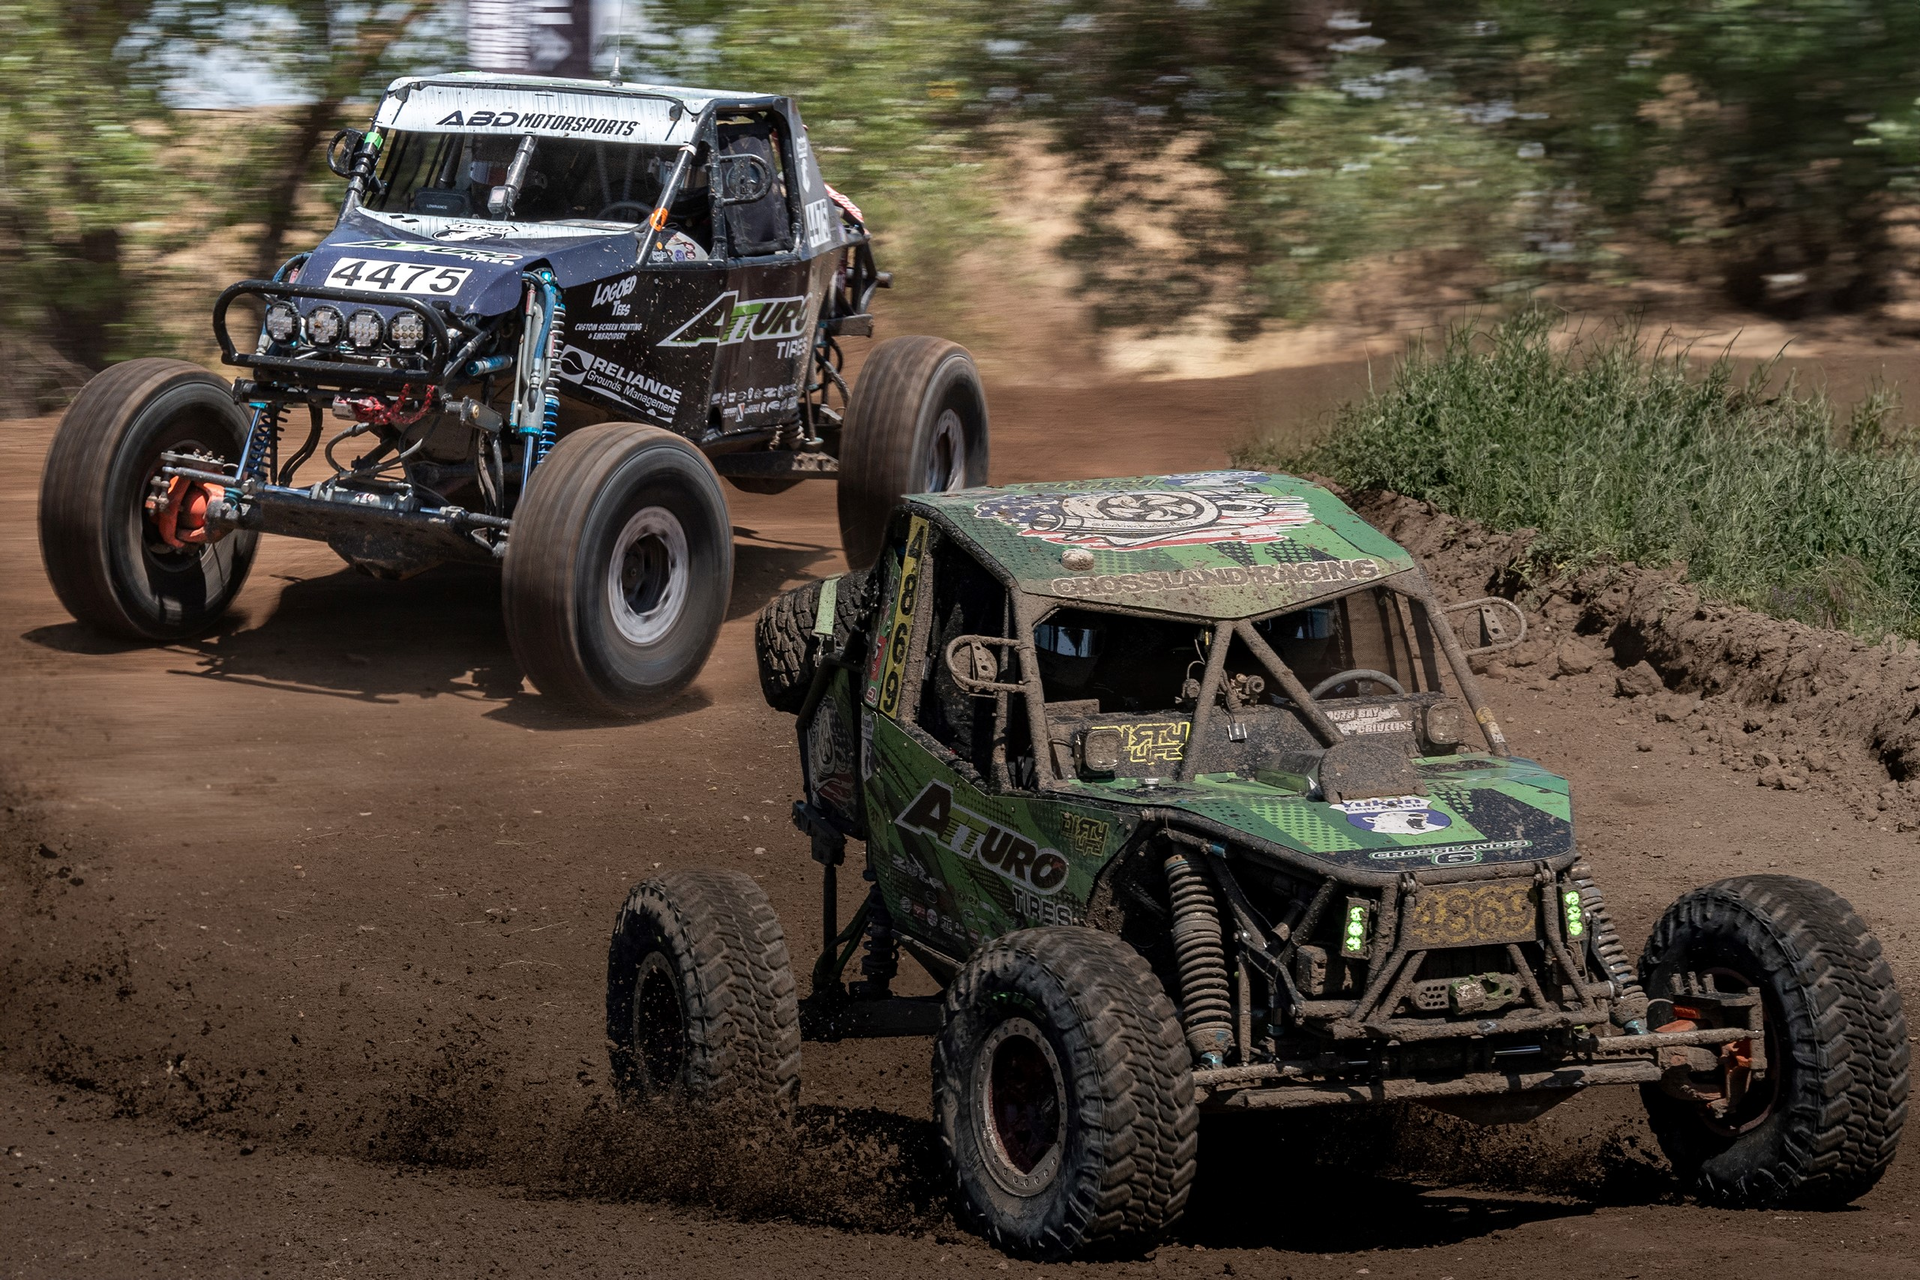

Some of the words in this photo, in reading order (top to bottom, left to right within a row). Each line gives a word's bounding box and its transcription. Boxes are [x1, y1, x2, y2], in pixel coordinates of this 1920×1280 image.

[436, 110, 519, 127] ABD
[517, 112, 640, 136] MOTORSPORTS
[331, 260, 467, 293] 4475
[460, 255, 515, 266] TIRES
[591, 275, 638, 308] LOGOED
[611, 300, 631, 316] TEES
[574, 323, 598, 331] CUSTOM
[598, 323, 618, 331] SCREEN
[618, 322, 643, 331] PRINTING
[592, 332, 628, 340] EMBROIDERY
[587, 371, 622, 392] Grounds
[623, 385, 677, 415] Management
[591, 356, 682, 404] RELIANCE
[1051, 566, 1250, 597] CROSSLAND
[1250, 558, 1381, 586] RACING
[883, 525, 925, 713] 4869
[1358, 708, 1379, 718] BAY
[894, 778, 1069, 895] ATTURO
[1372, 840, 1528, 859] CROSSLAND'S
[1012, 884, 1073, 926] TIRES
[1415, 888, 1535, 940] 4869
